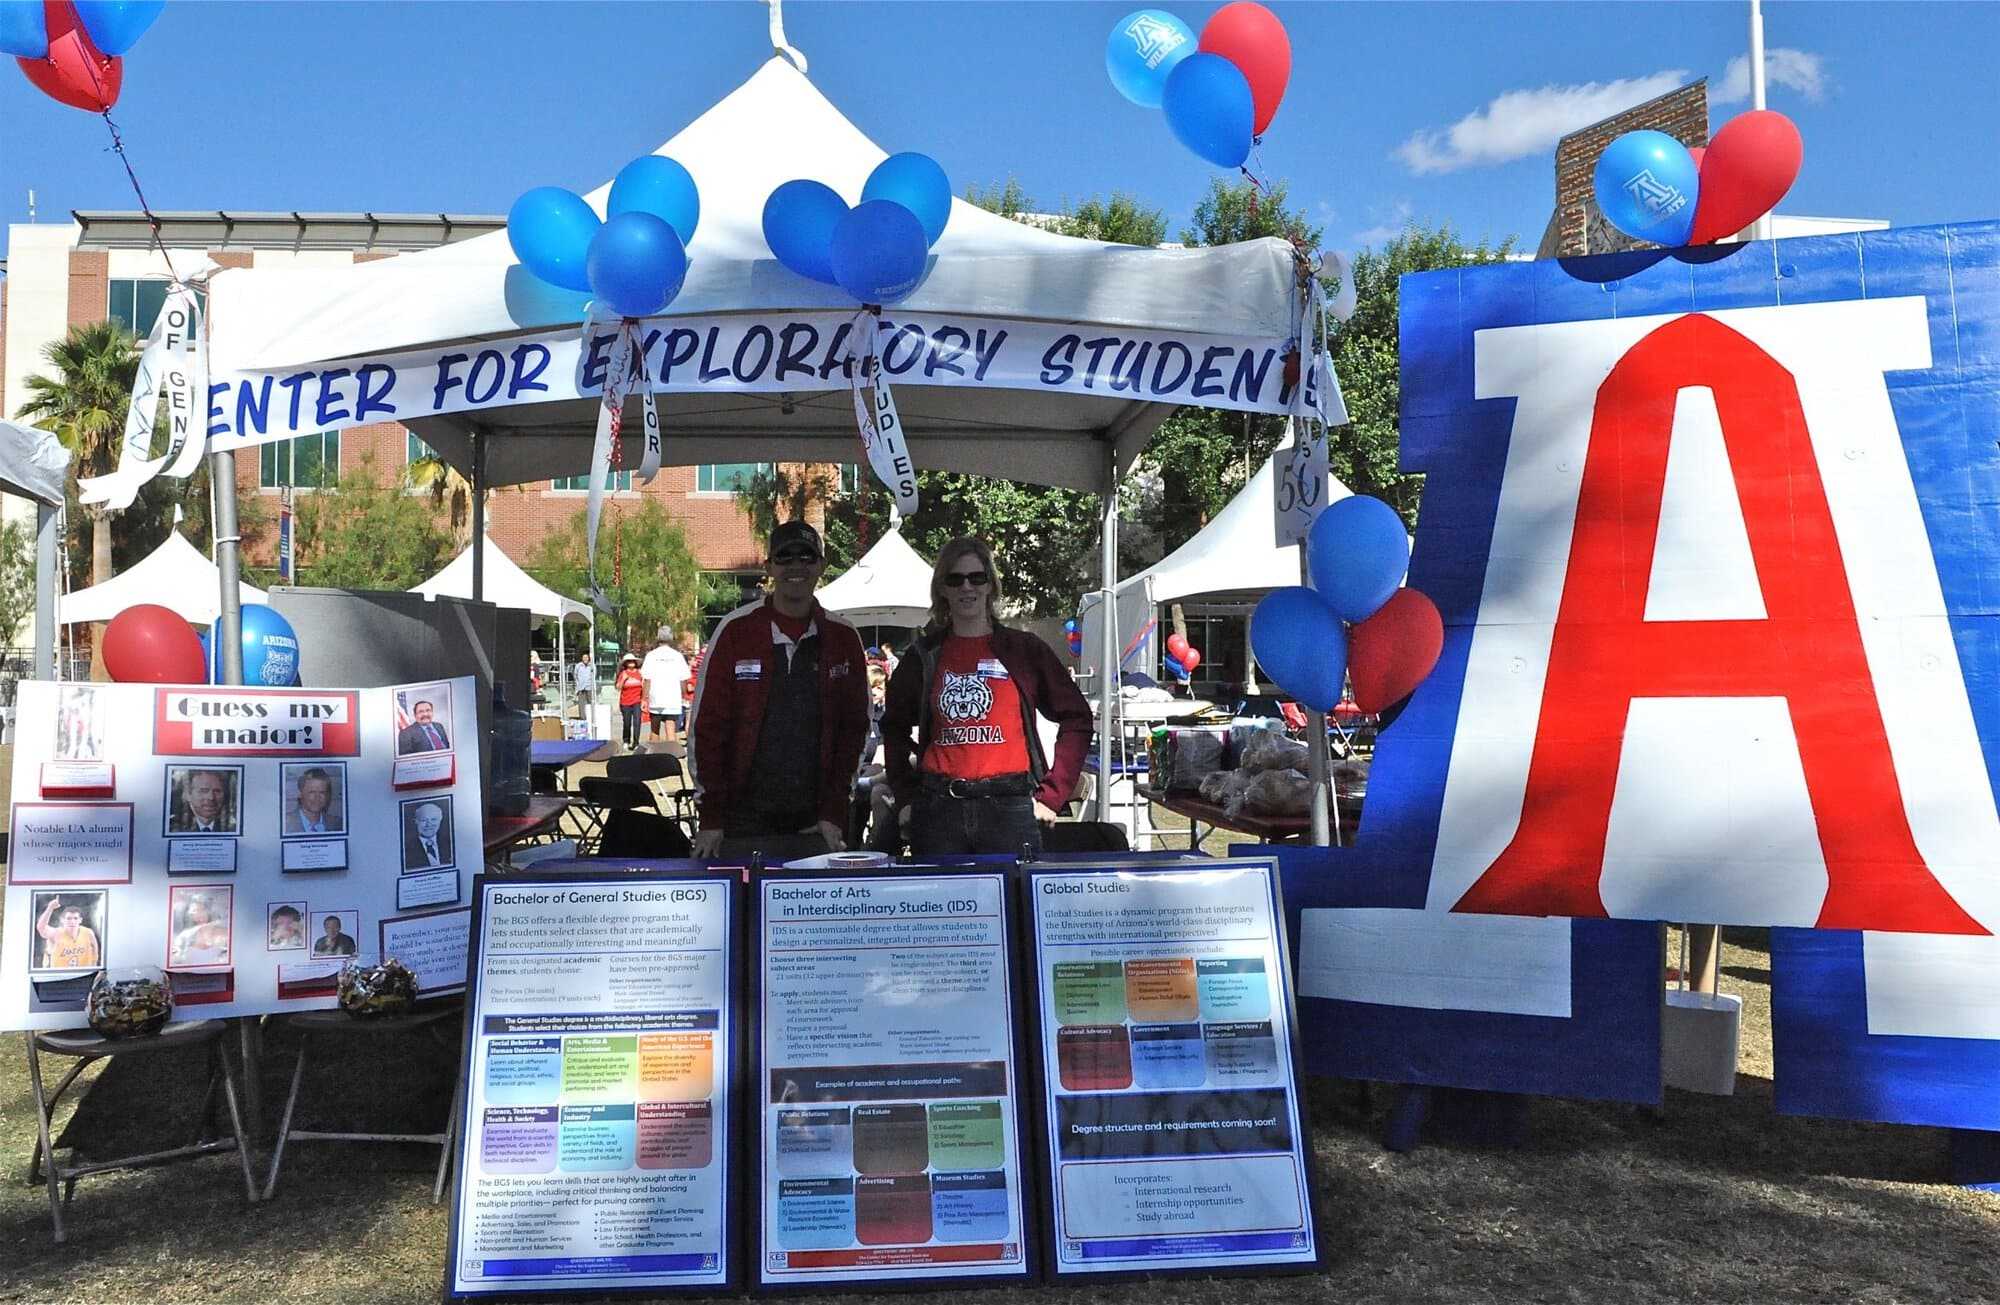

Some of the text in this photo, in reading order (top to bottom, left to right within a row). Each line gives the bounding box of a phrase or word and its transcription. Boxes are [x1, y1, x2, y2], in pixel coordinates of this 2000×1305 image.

[167, 311, 185, 350] OF
[207, 364, 397, 438] ENTER
[434, 343, 551, 410] FOR
[872, 356, 914, 498] STUDIES
[1443, 308, 1998, 942] A
[262, 635, 297, 650] ARIZONA
[178, 698, 339, 722] Guess my
[203, 726, 313, 746] major!
[24, 824, 123, 833] Notable UA alumni
[772, 887, 870, 899] Bachelor of Arts
[1044, 881, 1130, 894] Global Studies
[494, 890, 707, 904] Bachelor of General Studies (BGS)
[784, 901, 977, 918] in Interdisciplinary Studies (IDS)
[1045, 909, 1071, 917] Global
[1073, 908, 1103, 917] Studies
[1121, 907, 1155, 918] dynamic
[1158, 908, 1193, 916] program
[1213, 904, 1254, 915] integrates
[566, 915, 596, 923] flexible
[600, 915, 629, 925] degree
[632, 916, 669, 924] program
[1061, 919, 1103, 930] University
[1117, 918, 1153, 926] Arizona's
[1155, 917, 1203, 925] world-class
[1205, 915, 1252, 926] disciplinary
[509, 928, 547, 936] students
[577, 927, 607, 935] classes
[646, 925, 702, 936] academically
[805, 925, 860, 934] customizable
[863, 924, 891, 934] degree
[912, 923, 939, 931] allows
[941, 922, 977, 930] students
[1046, 931, 1085, 942] strengths
[1108, 929, 1161, 938] international
[1164, 928, 1218, 938] perspectives!
[509, 940, 572, 950] occupationally
[576, 939, 624, 949] interesting
[645, 937, 697, 948] meaningful!
[772, 938, 800, 948] design
[809, 936, 865, 947] personalized,
[868, 935, 911, 945] integrated
[962, 933, 987, 943] study!
[1145, 946, 1194, 956] opportunities
[1072, 1117, 1276, 1135] Degree structure and requirements coming soon!
[617, 1175, 639, 1185] highly
[641, 1174, 666, 1184] sought
[859, 1177, 894, 1186] Advertising
[1114, 1173, 1172, 1187] Incorporates:
[491, 1188, 533, 1198] workplace,
[536, 1188, 570, 1198] including
[600, 1186, 630, 1196] thinking
[650, 1185, 687, 1195] balancing
[1135, 1183, 1231, 1195] International research
[476, 1199, 508, 1209] multiple
[510, 1198, 550, 1208] priorities—
[552, 1197, 580, 1207] perfect
[593, 1196, 626, 1206] pursuing
[1136, 1195, 1244, 1211] Internship opportunities
[1136, 1210, 1194, 1223] Study abroad
